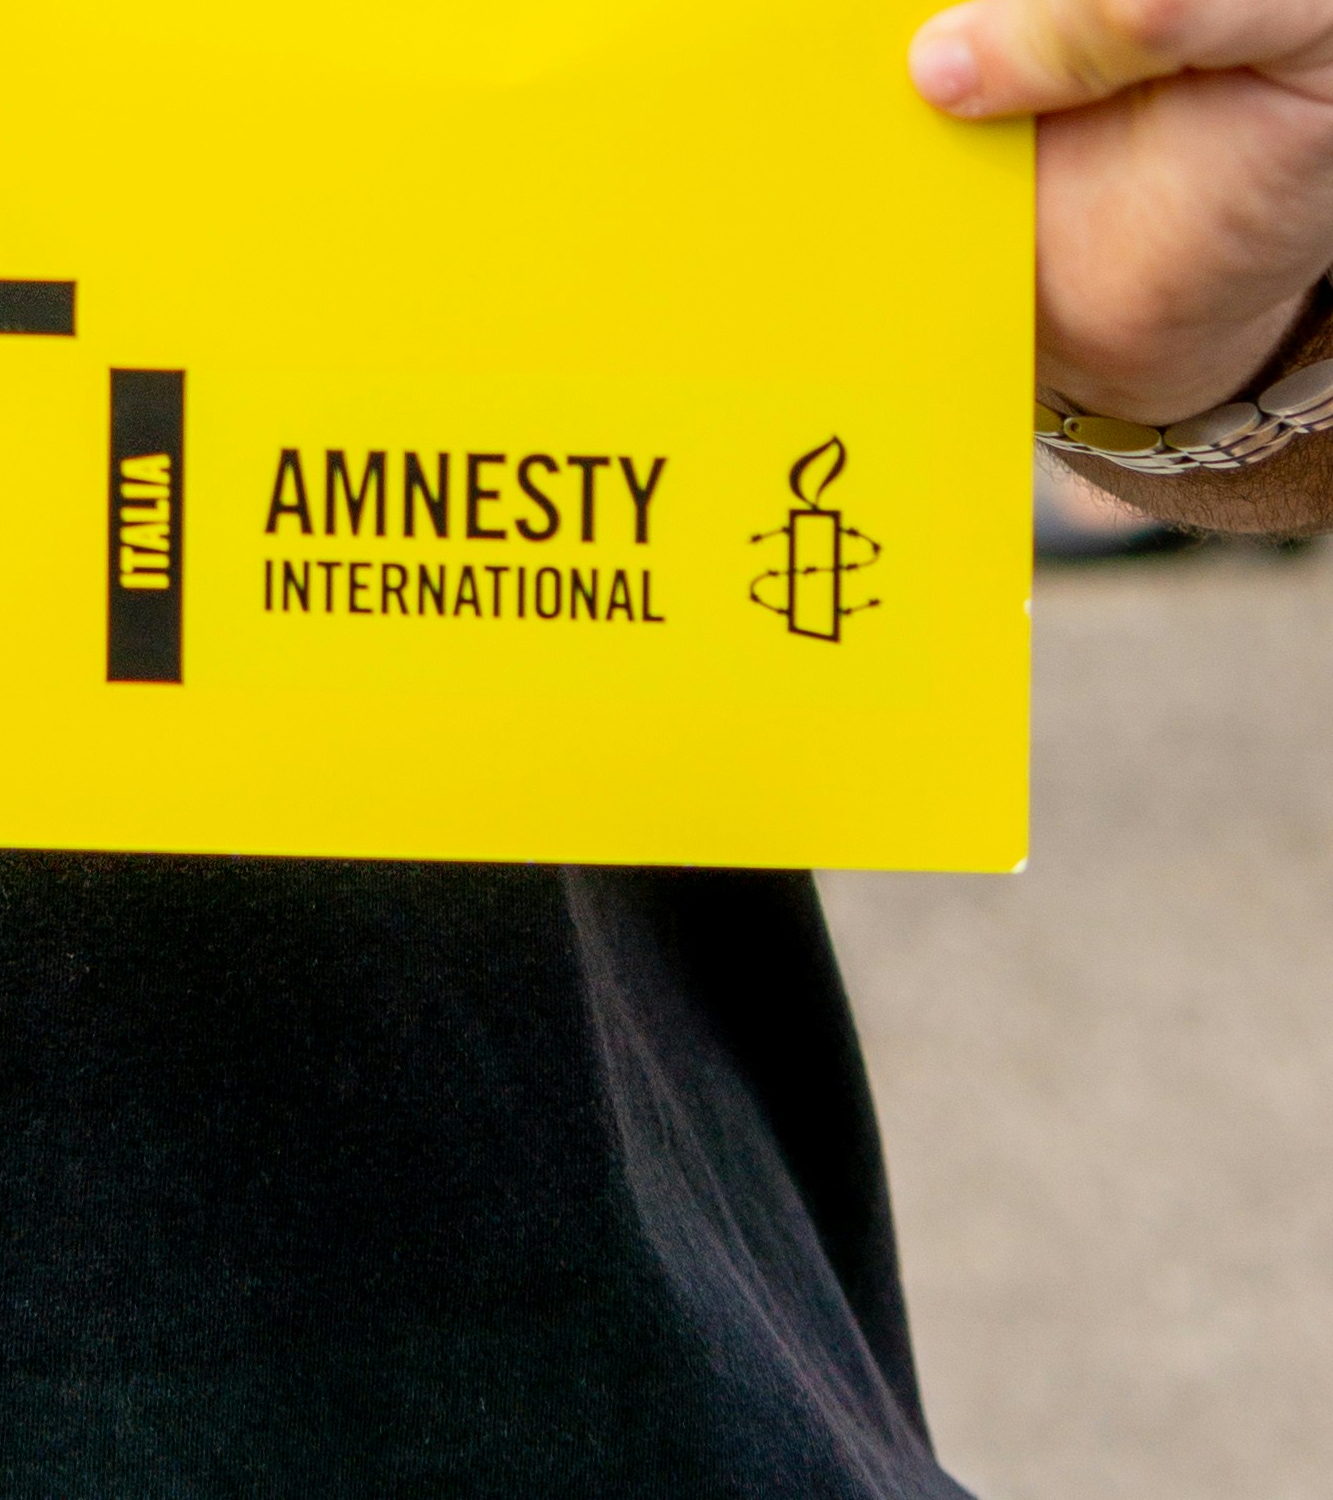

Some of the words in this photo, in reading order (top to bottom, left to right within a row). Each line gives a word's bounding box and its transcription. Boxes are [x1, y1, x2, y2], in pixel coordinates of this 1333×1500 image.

[119, 451, 174, 591] ITALIA
[263, 446, 667, 545] AMNESTY
[263, 558, 667, 624] INTERNATIONAL
